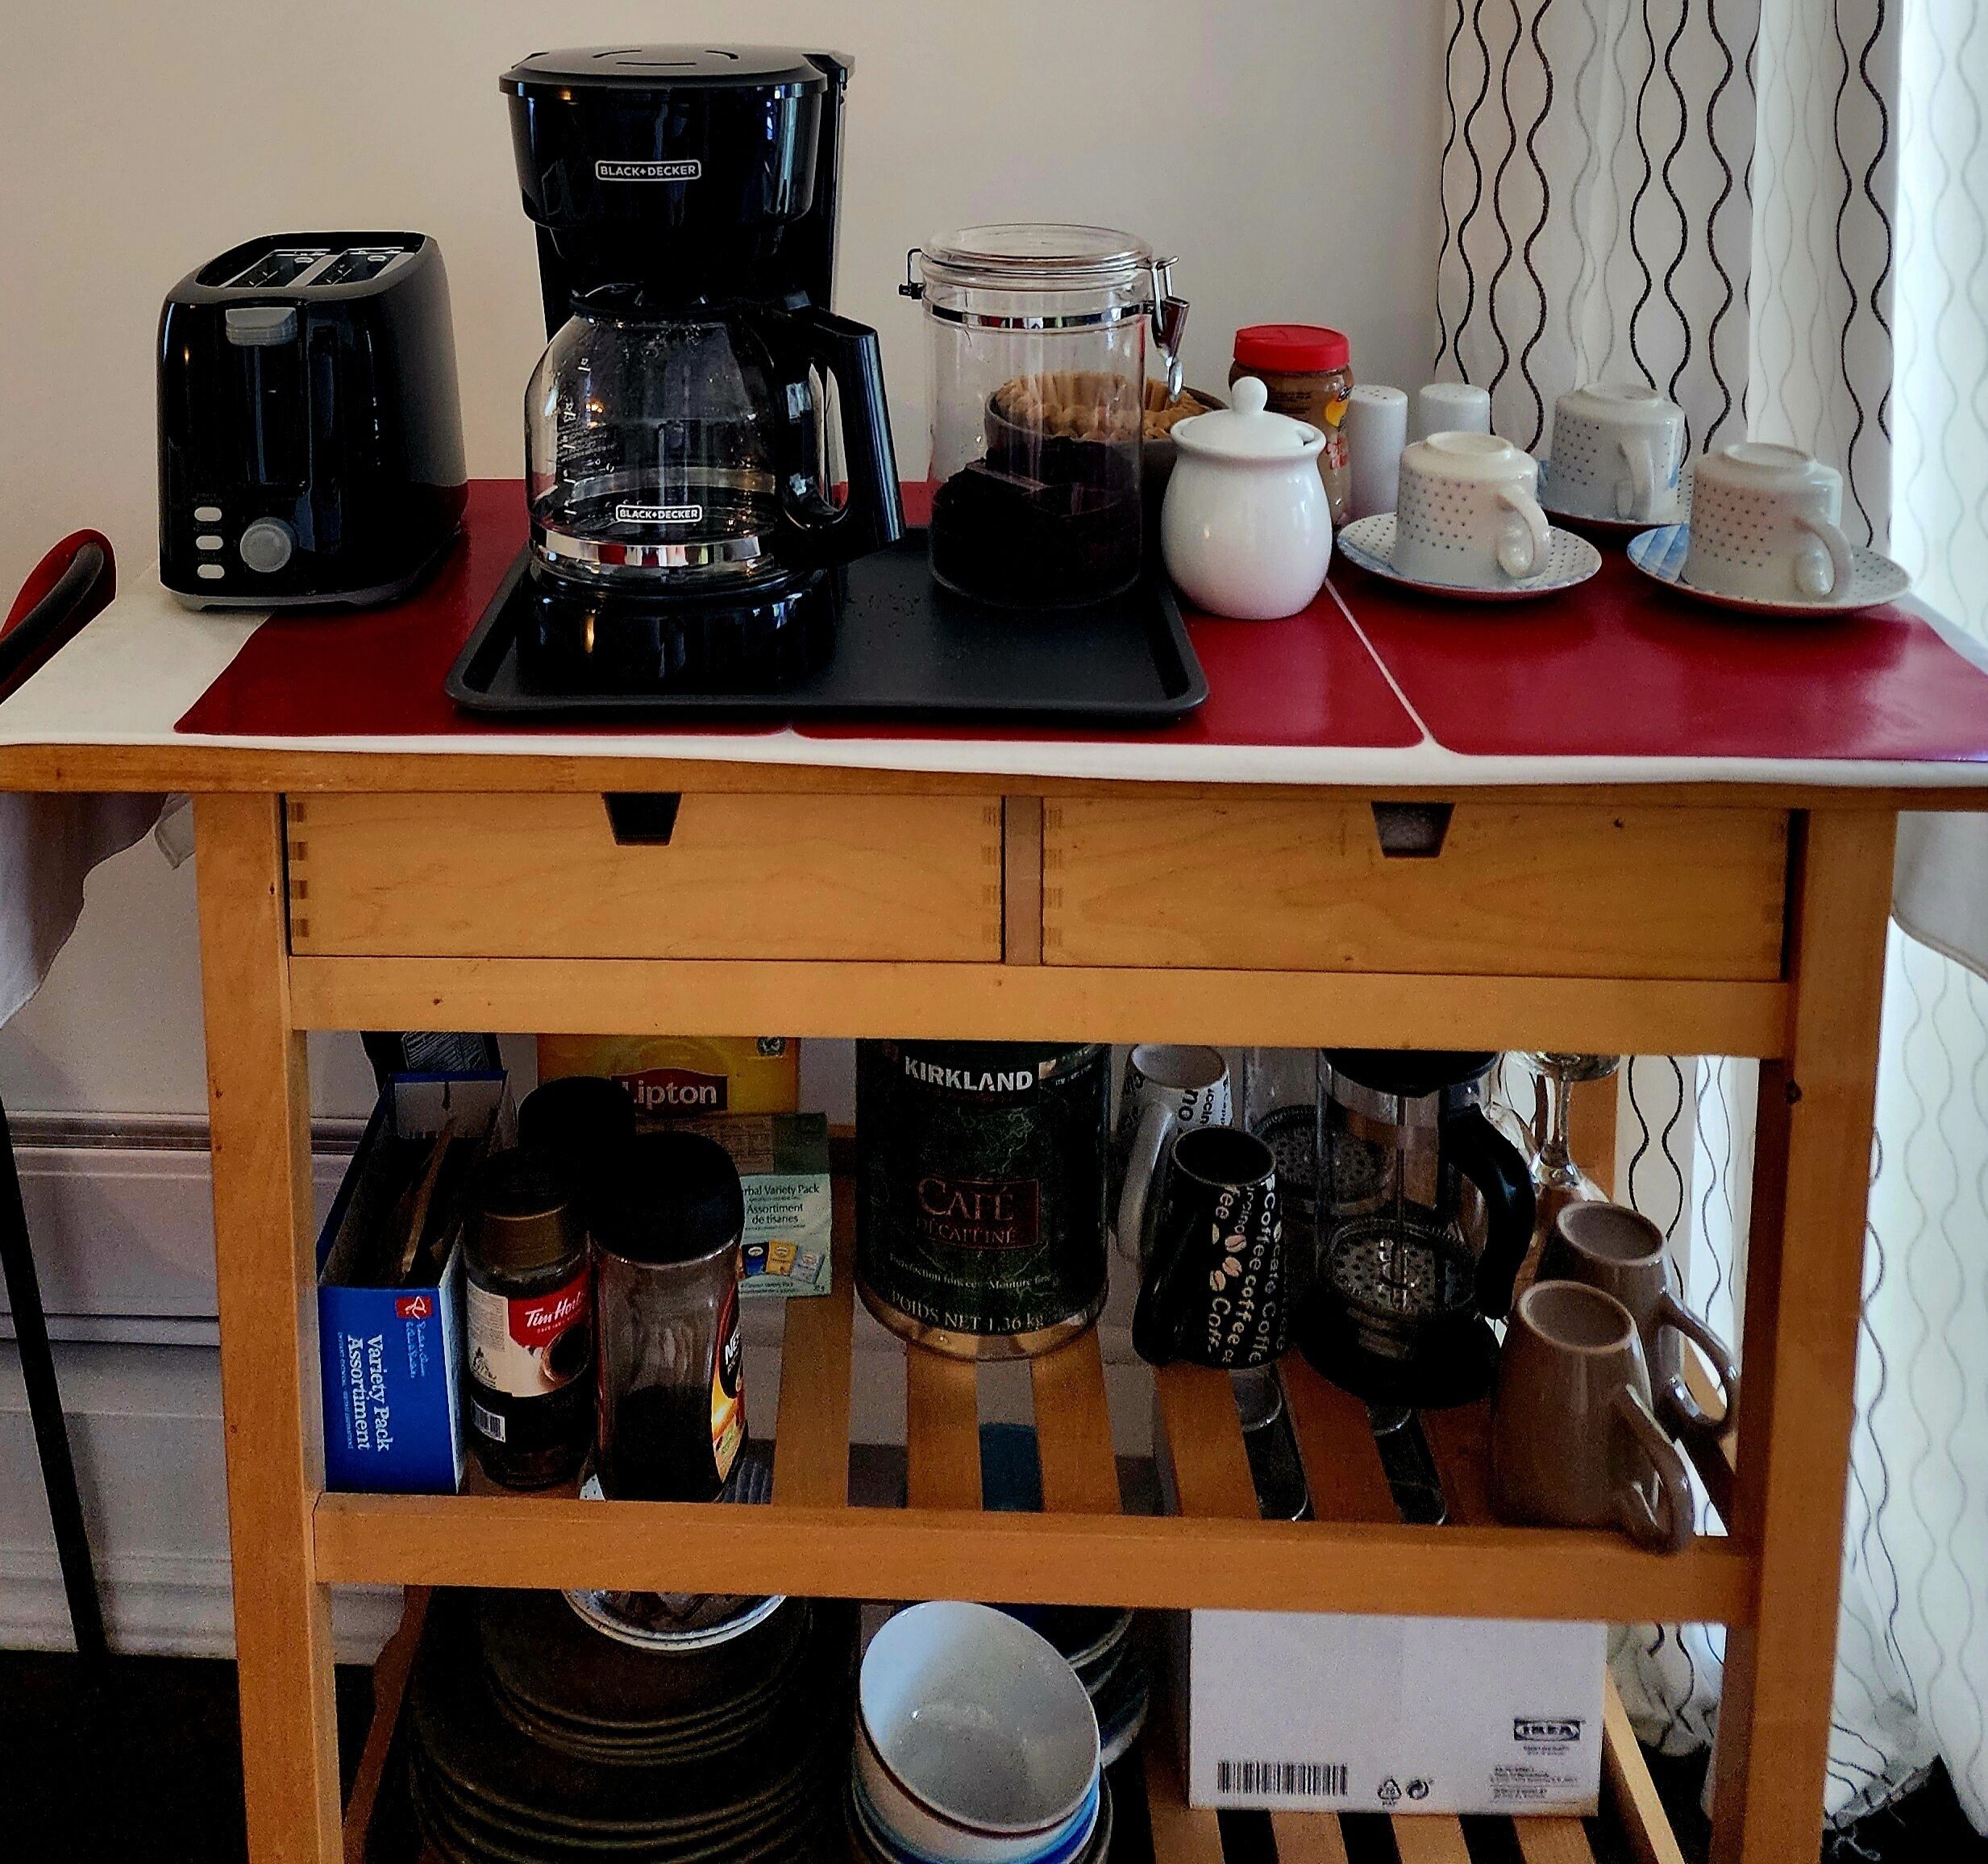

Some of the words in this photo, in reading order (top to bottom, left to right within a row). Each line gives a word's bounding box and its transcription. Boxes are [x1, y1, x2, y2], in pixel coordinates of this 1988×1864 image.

[600, 164, 697, 177] BLACK+DECKER
[619, 508, 698, 520] BLACK+DECKER
[905, 1055, 1034, 1092] KIRKLAND
[622, 1080, 717, 1110] ipton
[742, 1184, 763, 1196] rbal
[764, 1184, 796, 1197] Variety
[797, 1183, 820, 1194] Pack
[746, 1204, 804, 1214] Assortiment
[751, 1215, 765, 1225] de
[767, 1213, 799, 1224] tisanes
[1249, 1192, 1275, 1271] Coffee
[525, 1307, 552, 1329] Tim
[892, 1290, 939, 1323] POIDS
[944, 1311, 981, 1330] NET
[1026, 1312, 1045, 1330] kg
[1227, 1275, 1258, 1345] coffee
[367, 1334, 387, 1404] Variety
[347, 1334, 372, 1450] Assortiment
[373, 1405, 394, 1452] Pack
